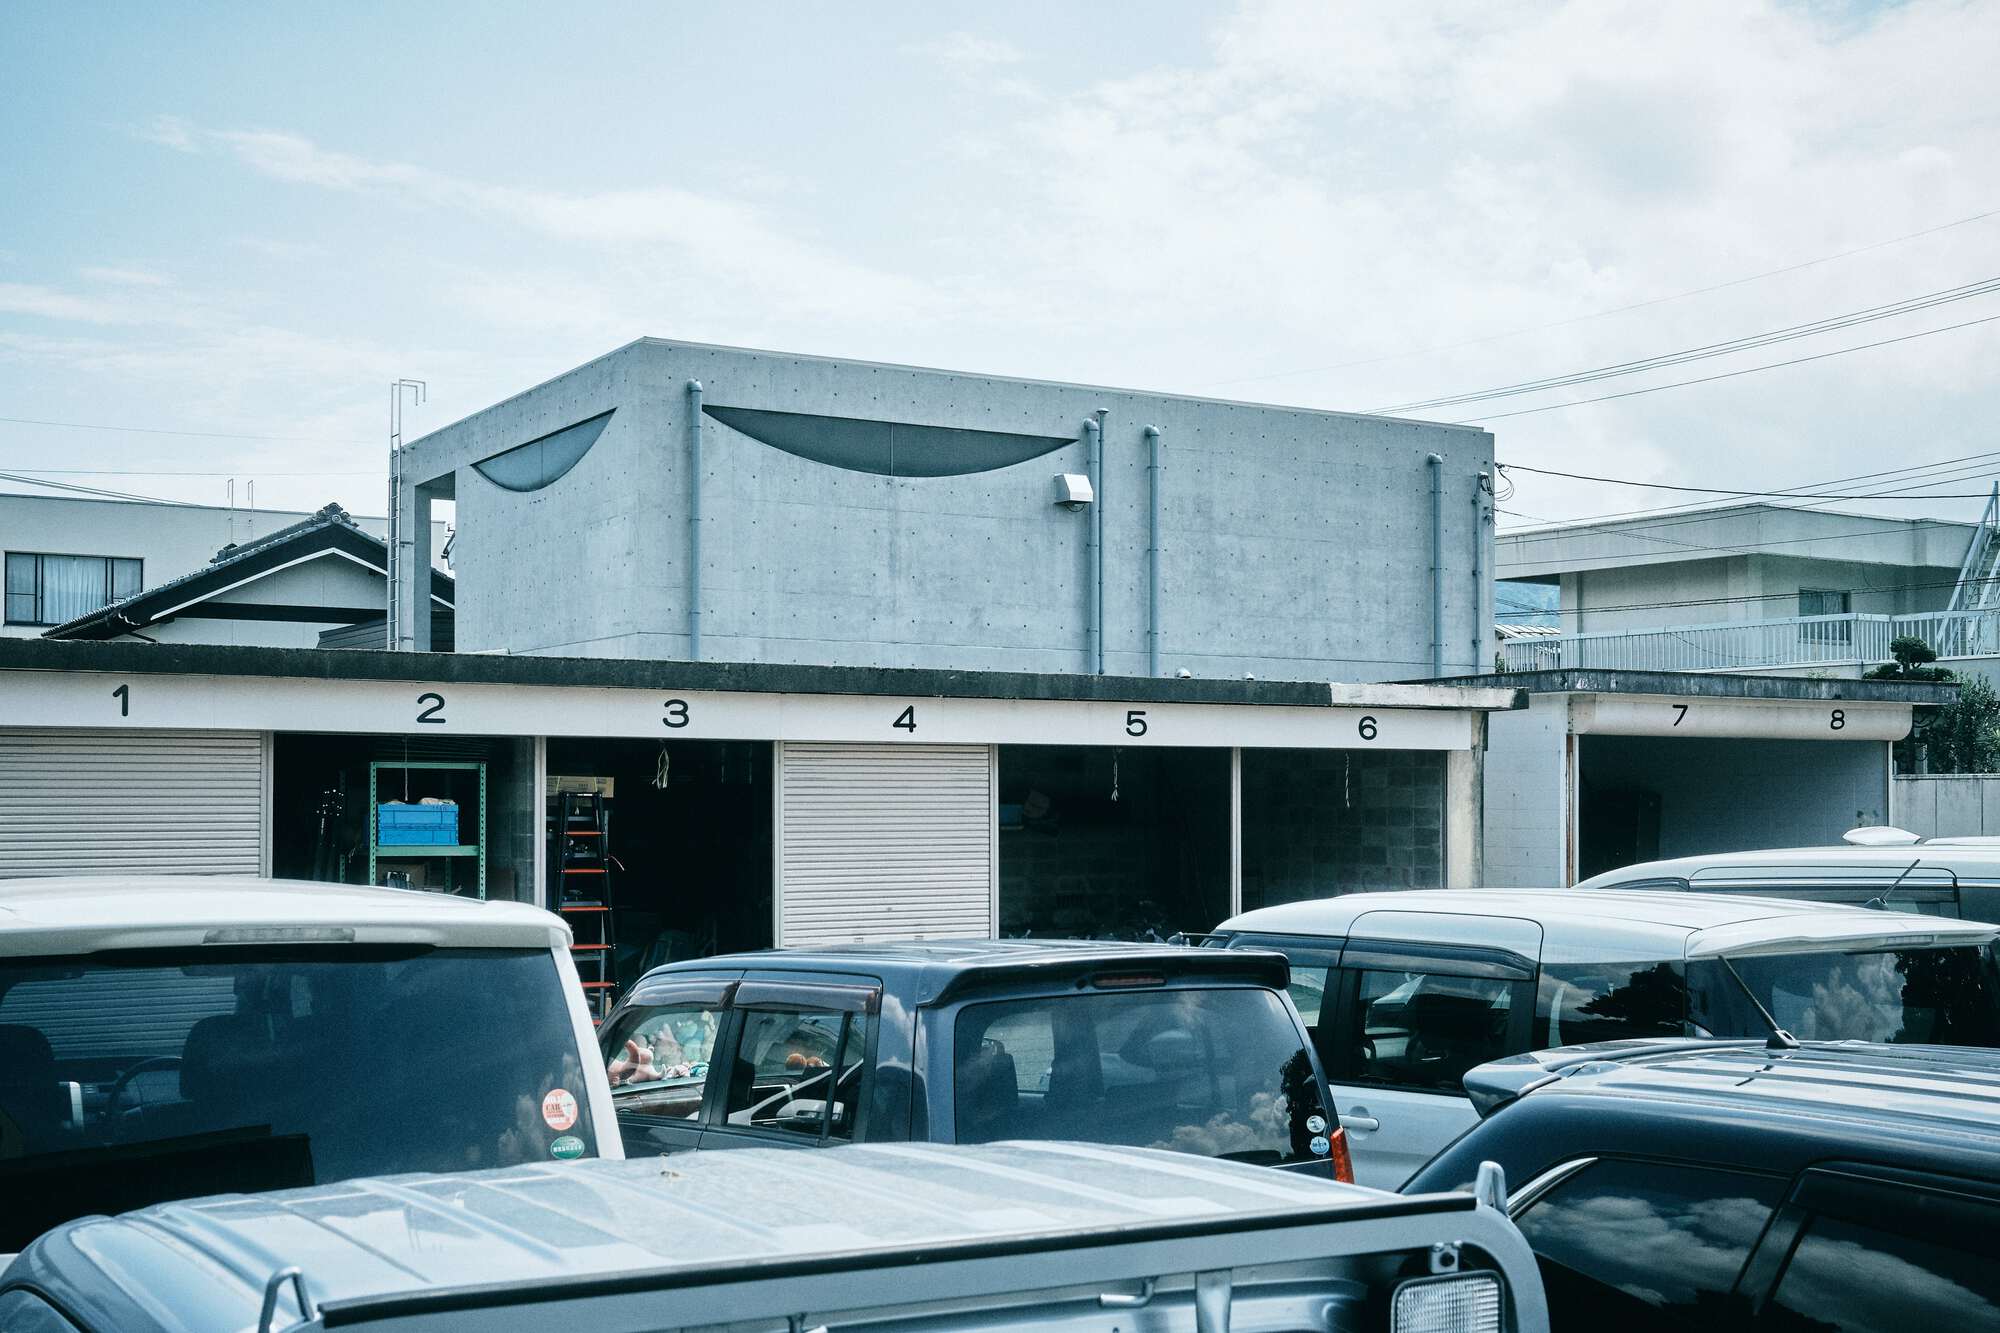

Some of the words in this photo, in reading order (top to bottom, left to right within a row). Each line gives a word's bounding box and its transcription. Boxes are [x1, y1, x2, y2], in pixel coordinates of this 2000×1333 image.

[112, 684, 128, 717] 1
[416, 693, 446, 723] 2
[662, 698, 689, 728] 3
[892, 704, 917, 733] 4
[1126, 711, 1147, 736] 5
[1359, 716, 1378, 740] 6
[1672, 703, 1689, 727] 7
[1830, 709, 1846, 731] 8
